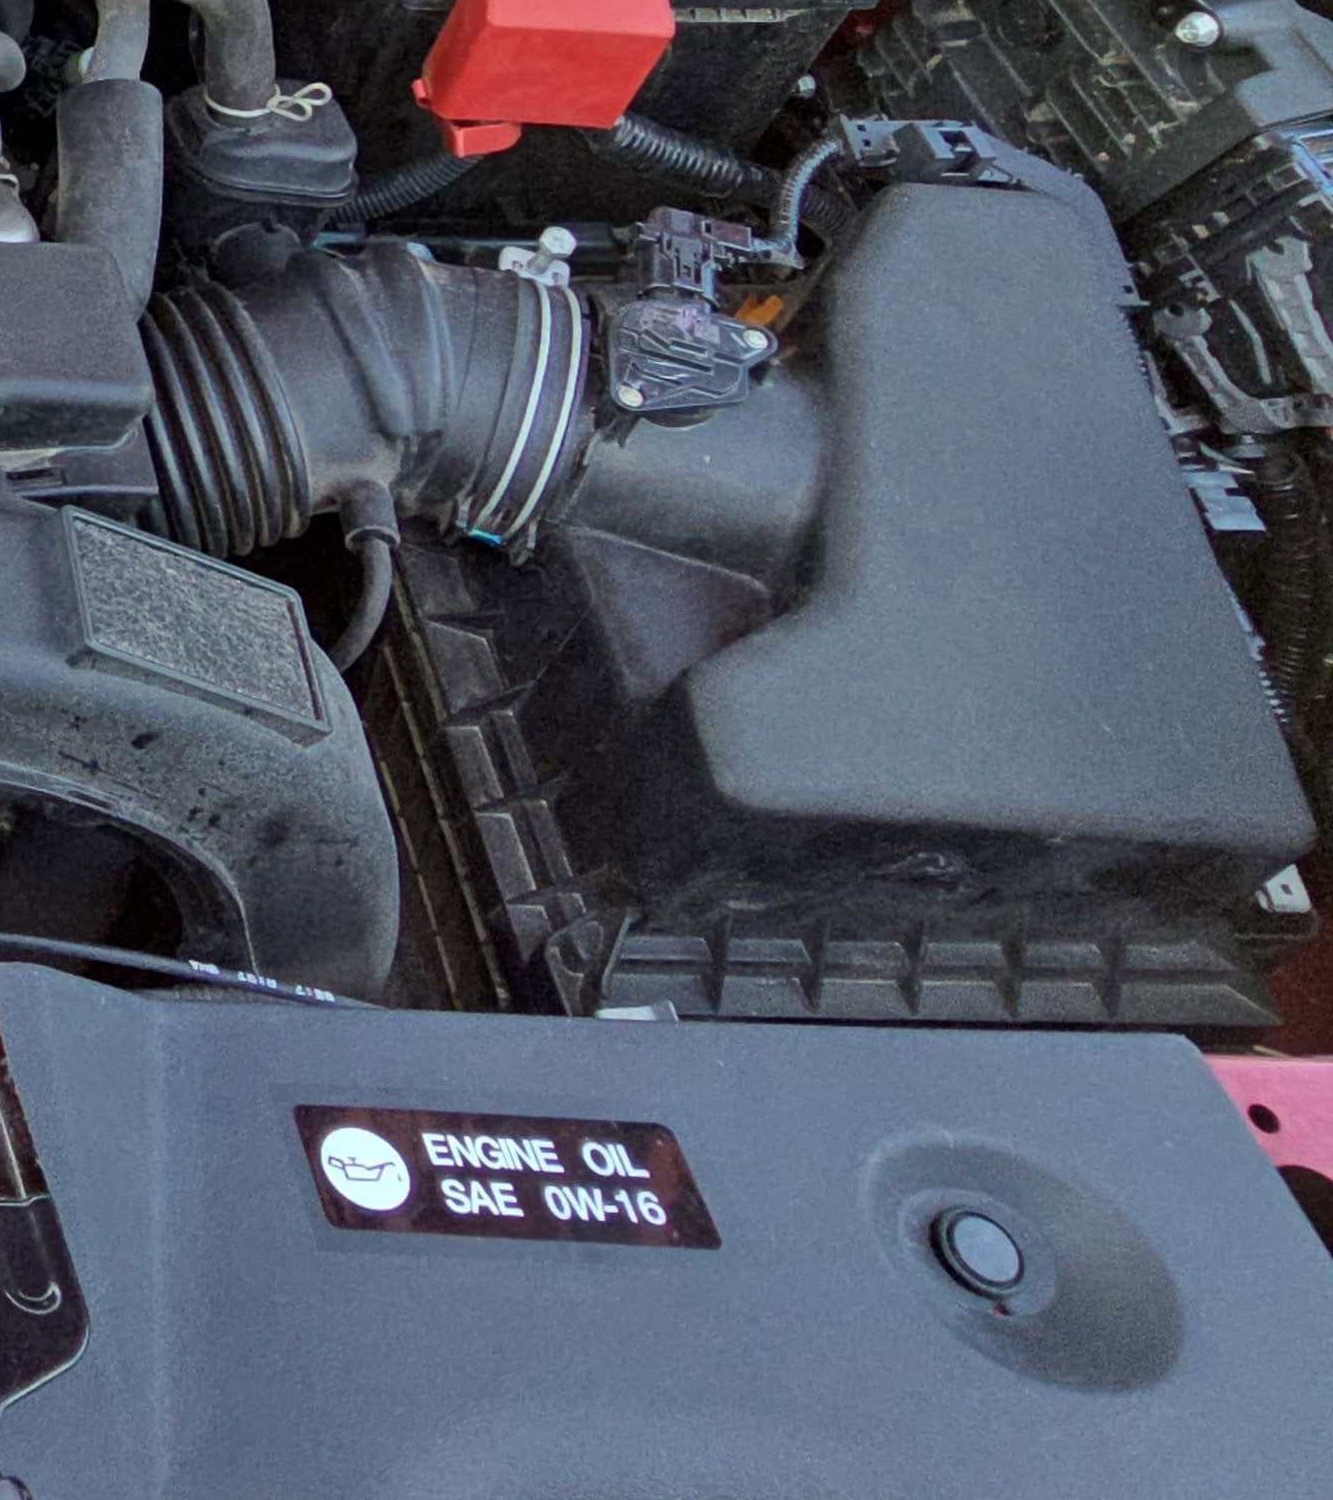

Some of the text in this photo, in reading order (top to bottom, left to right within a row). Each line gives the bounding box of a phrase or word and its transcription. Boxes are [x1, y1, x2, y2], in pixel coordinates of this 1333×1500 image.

[422, 1132, 651, 1179] ENGINE OIL
[440, 1178, 668, 1226] SAE 0W-16
